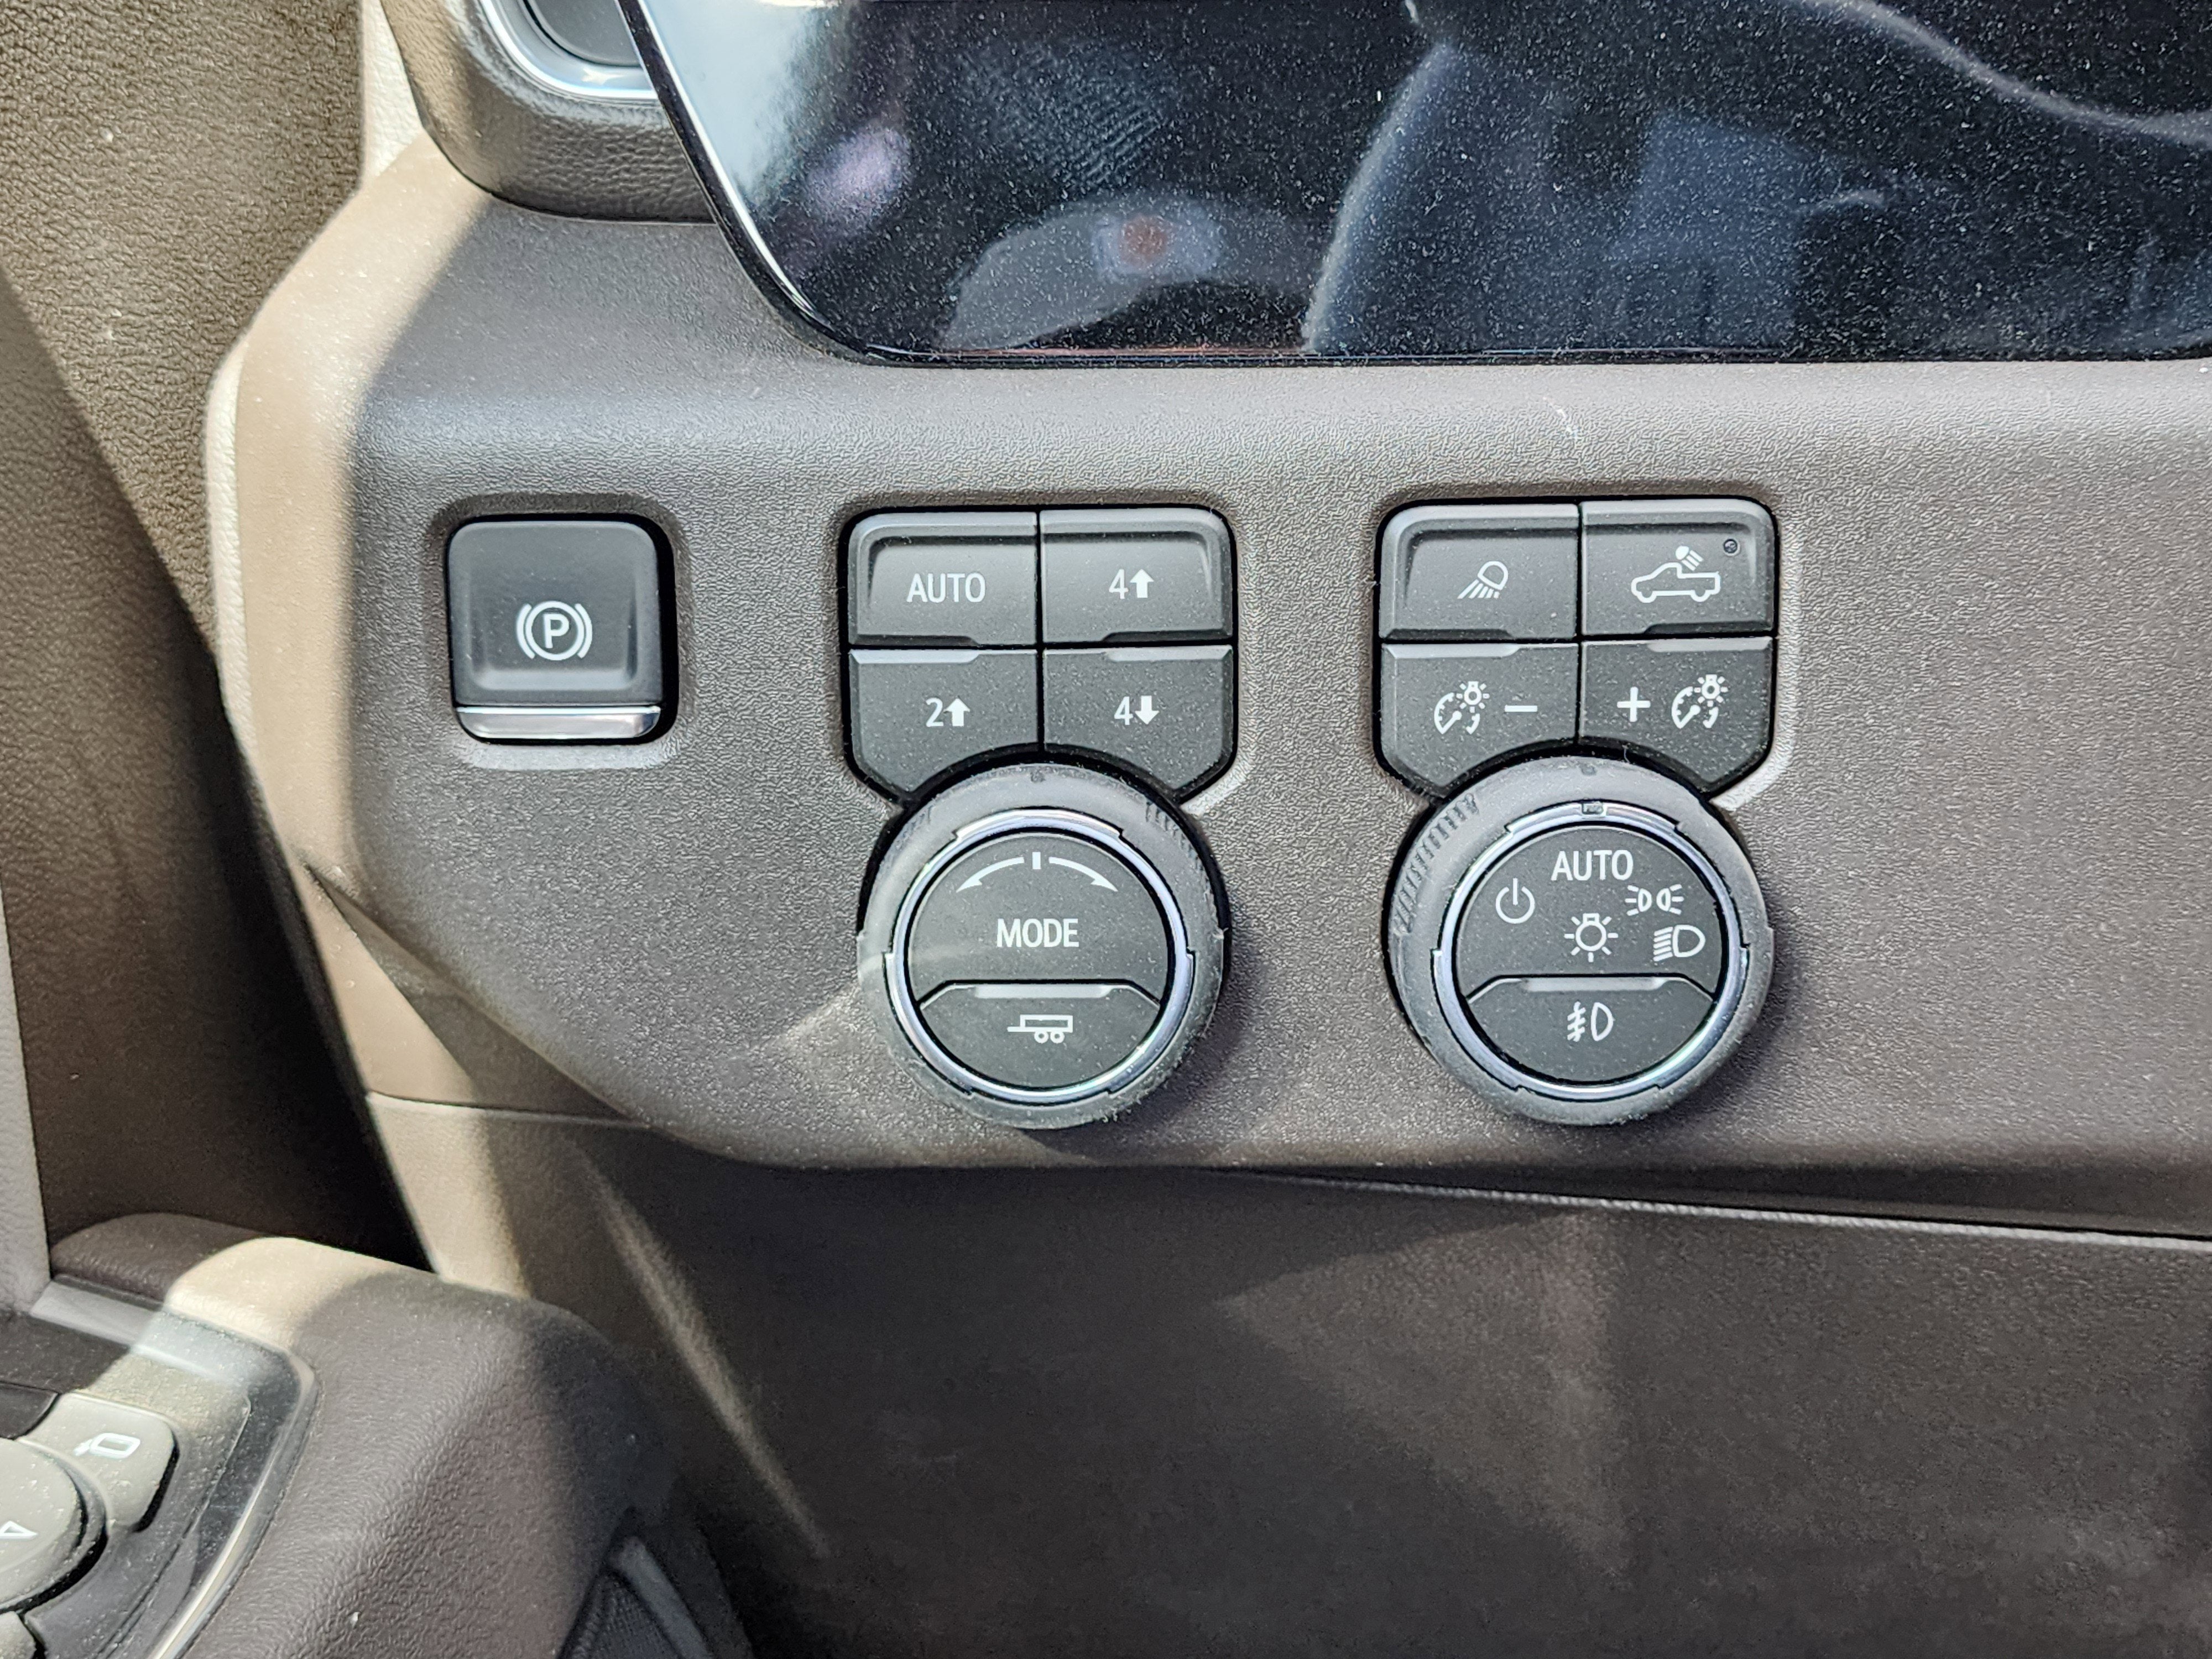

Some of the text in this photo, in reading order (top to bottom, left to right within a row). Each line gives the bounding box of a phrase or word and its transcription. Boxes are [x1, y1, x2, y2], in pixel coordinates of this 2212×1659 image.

[906, 572, 987, 603] AUTO
[1108, 569, 1129, 599] 4
[542, 613, 570, 649] P
[926, 697, 944, 728] 2
[1113, 696, 1134, 726] 4
[1551, 849, 1634, 881] AUTO
[996, 918, 1080, 948] MODE
